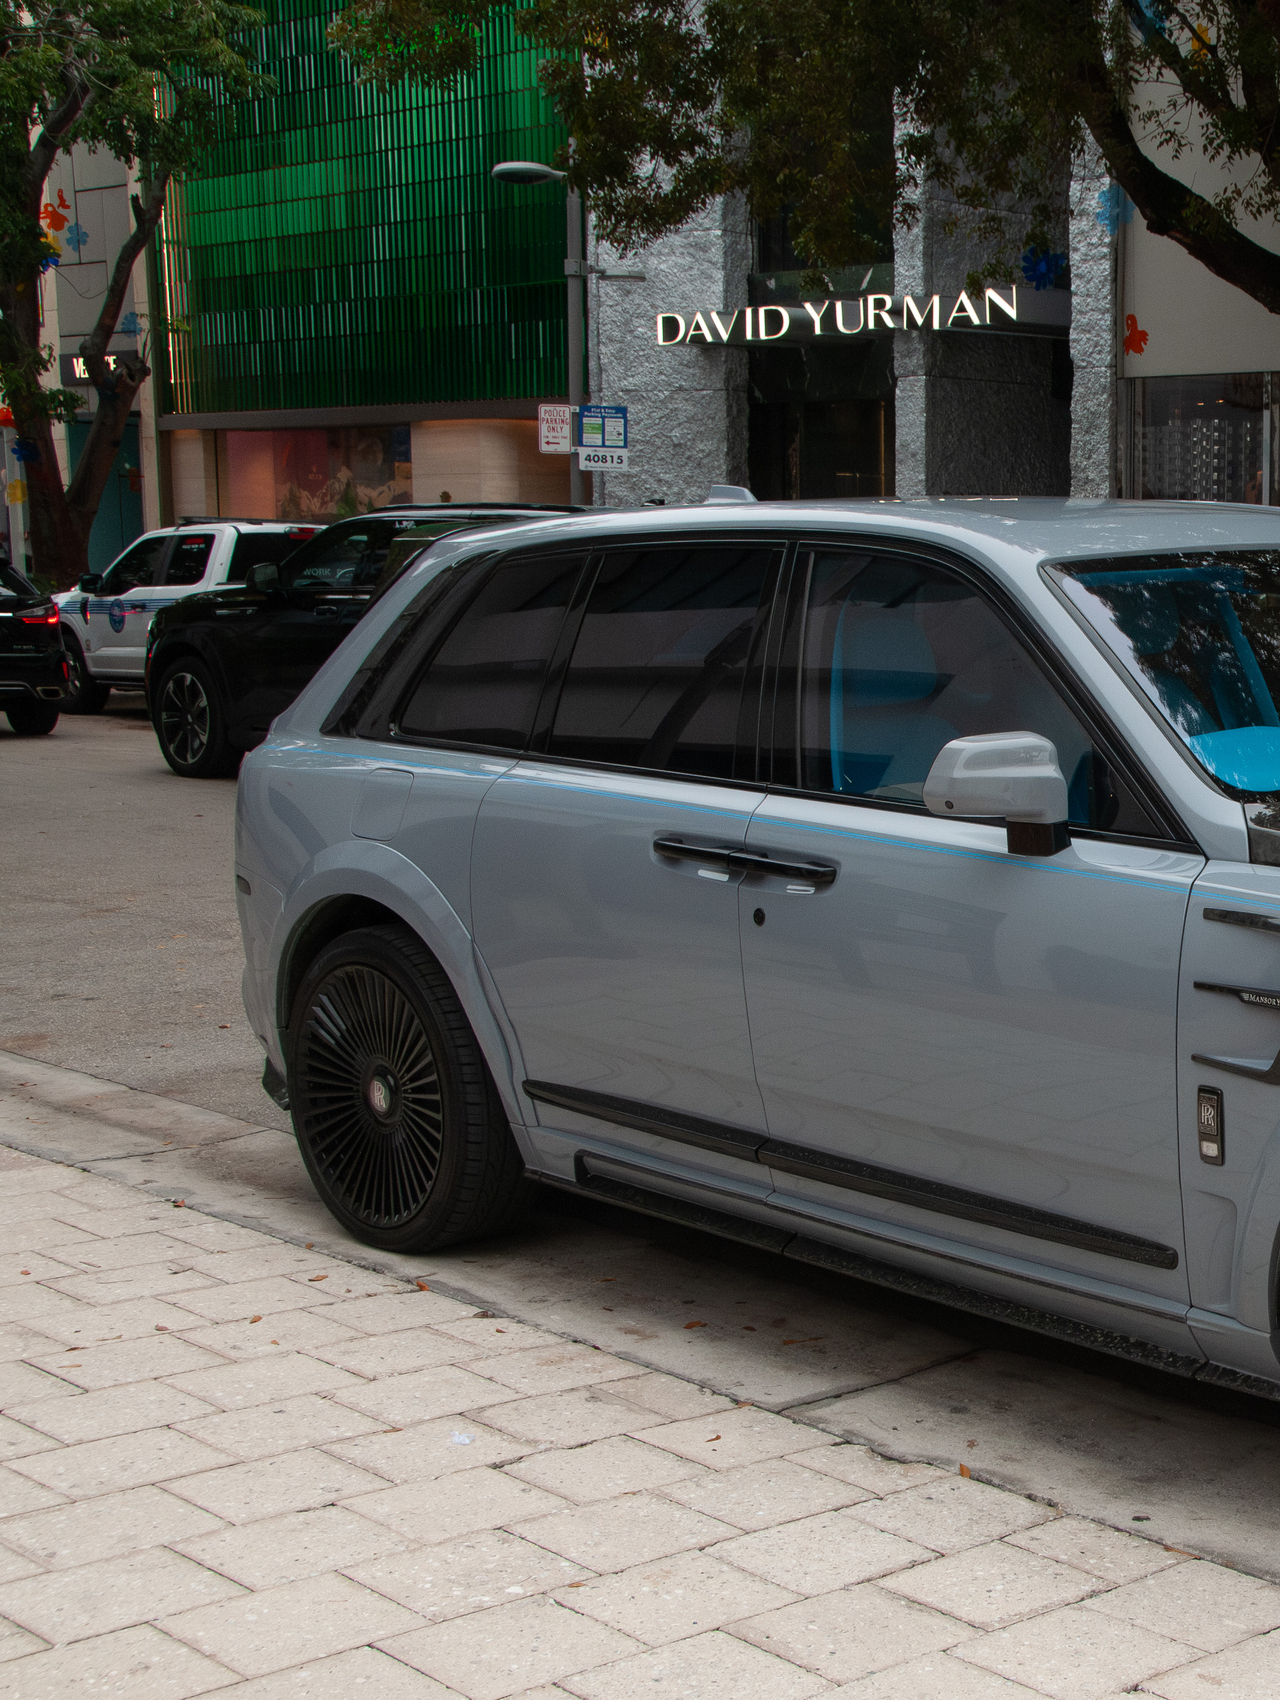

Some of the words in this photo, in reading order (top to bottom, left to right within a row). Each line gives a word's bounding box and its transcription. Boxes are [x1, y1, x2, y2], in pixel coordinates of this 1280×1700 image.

[656, 305, 790, 346] DAVID
[801, 284, 1017, 336] YURMAN
[544, 409, 566, 417] POLICE
[584, 454, 624, 465] 40815
